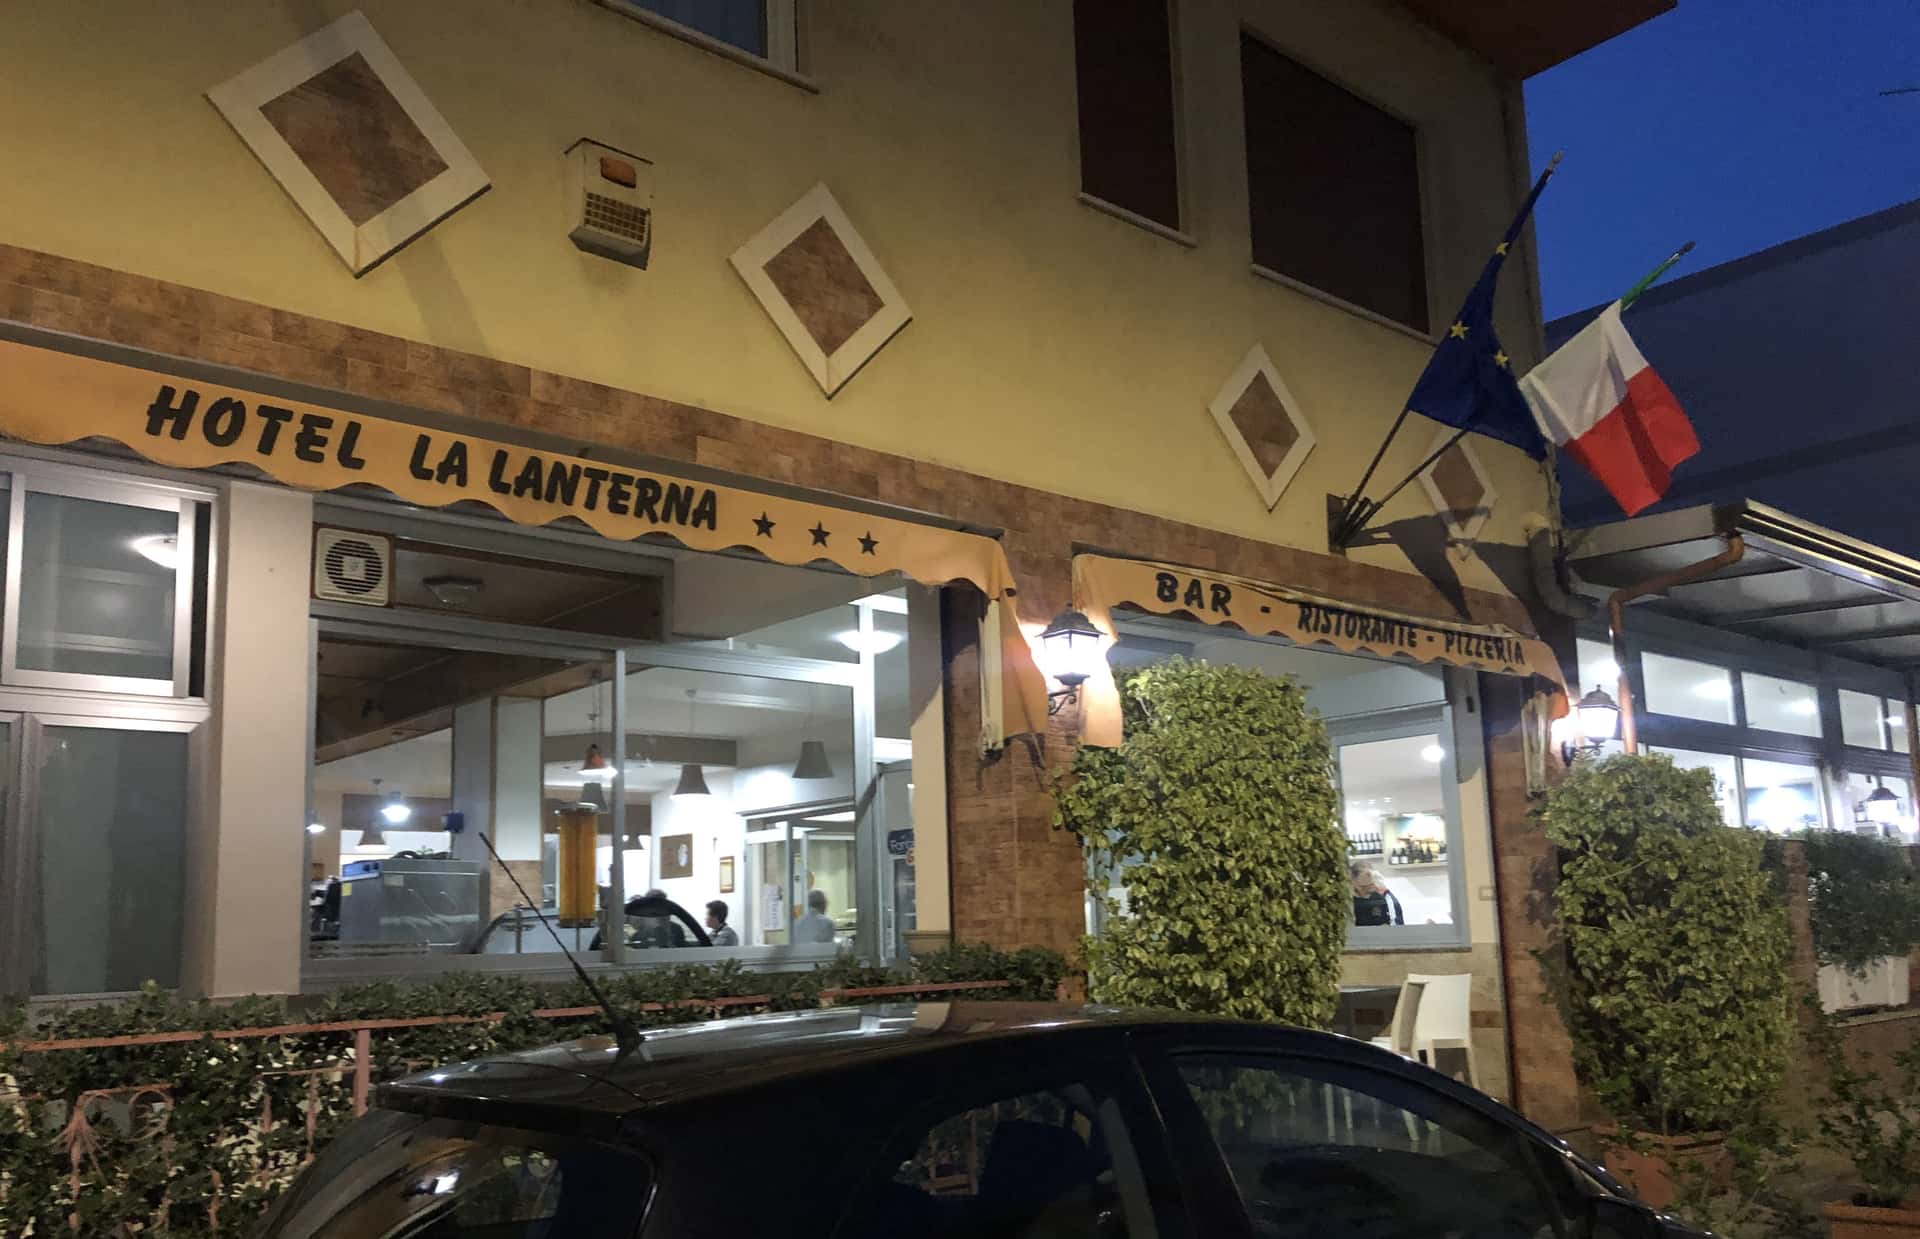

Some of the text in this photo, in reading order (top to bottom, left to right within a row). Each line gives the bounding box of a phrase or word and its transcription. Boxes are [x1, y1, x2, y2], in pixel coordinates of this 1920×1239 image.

[145, 384, 718, 531] HOTEL LA LANTERNA
[1155, 572, 1232, 617] BAR
[1297, 602, 1418, 649] RISTORANTE
[1444, 631, 1526, 665] PIZZERIA
